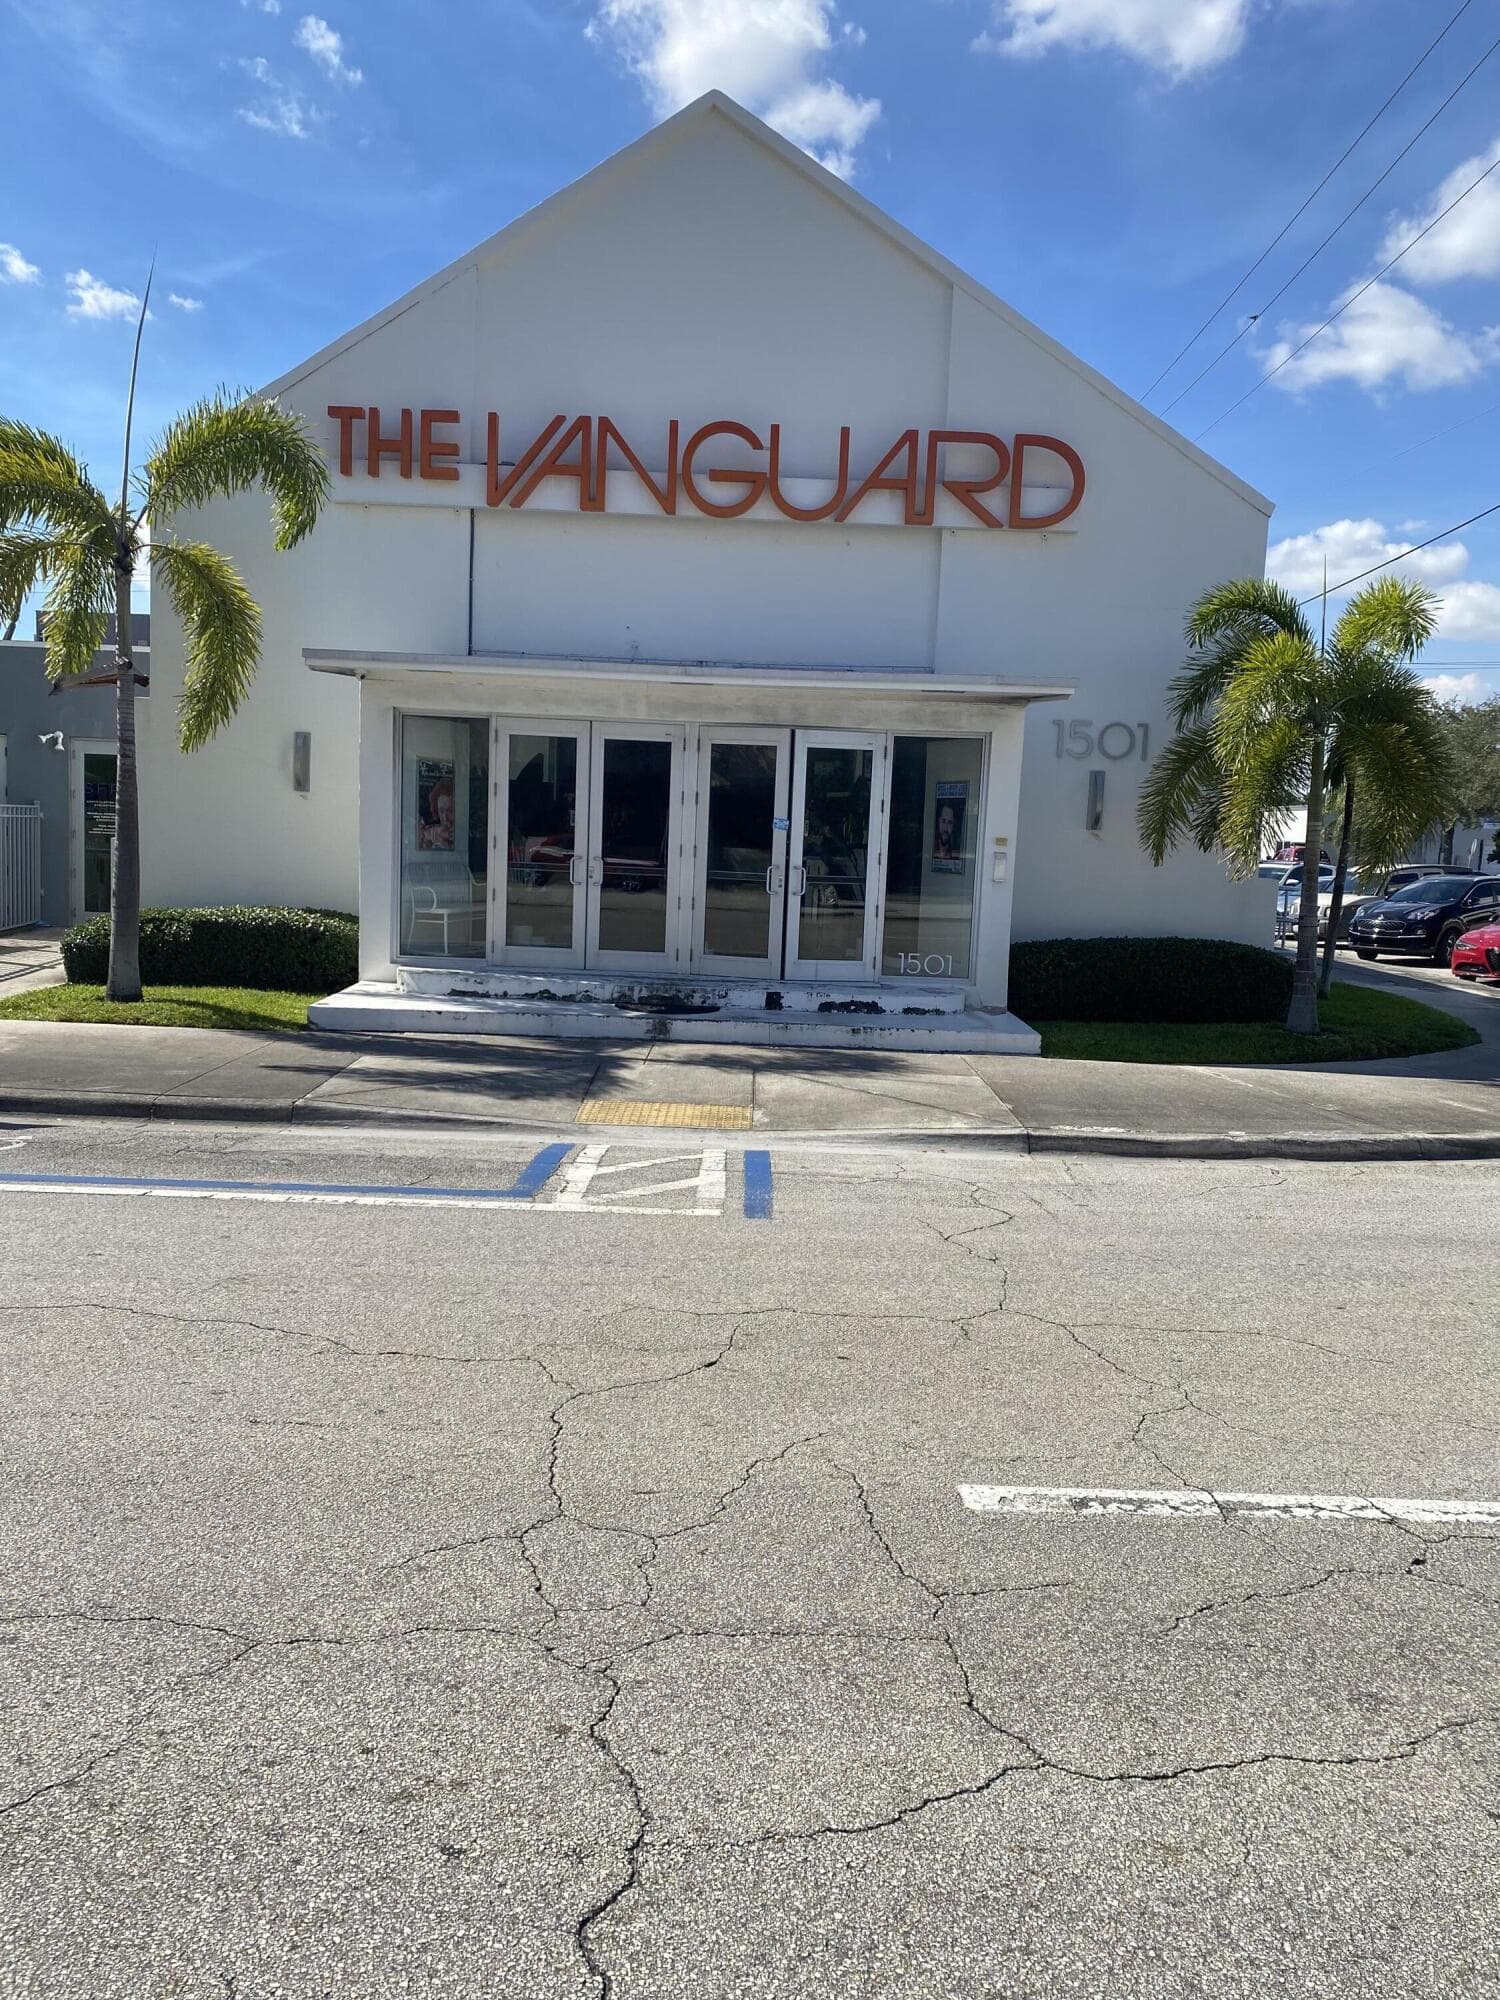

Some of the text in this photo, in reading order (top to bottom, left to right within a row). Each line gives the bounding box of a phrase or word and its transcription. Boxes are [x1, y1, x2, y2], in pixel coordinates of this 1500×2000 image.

[328, 406, 1085, 529] THE VANGUARD
[1052, 719, 1149, 761] 1501
[897, 952, 952, 976] 1501
